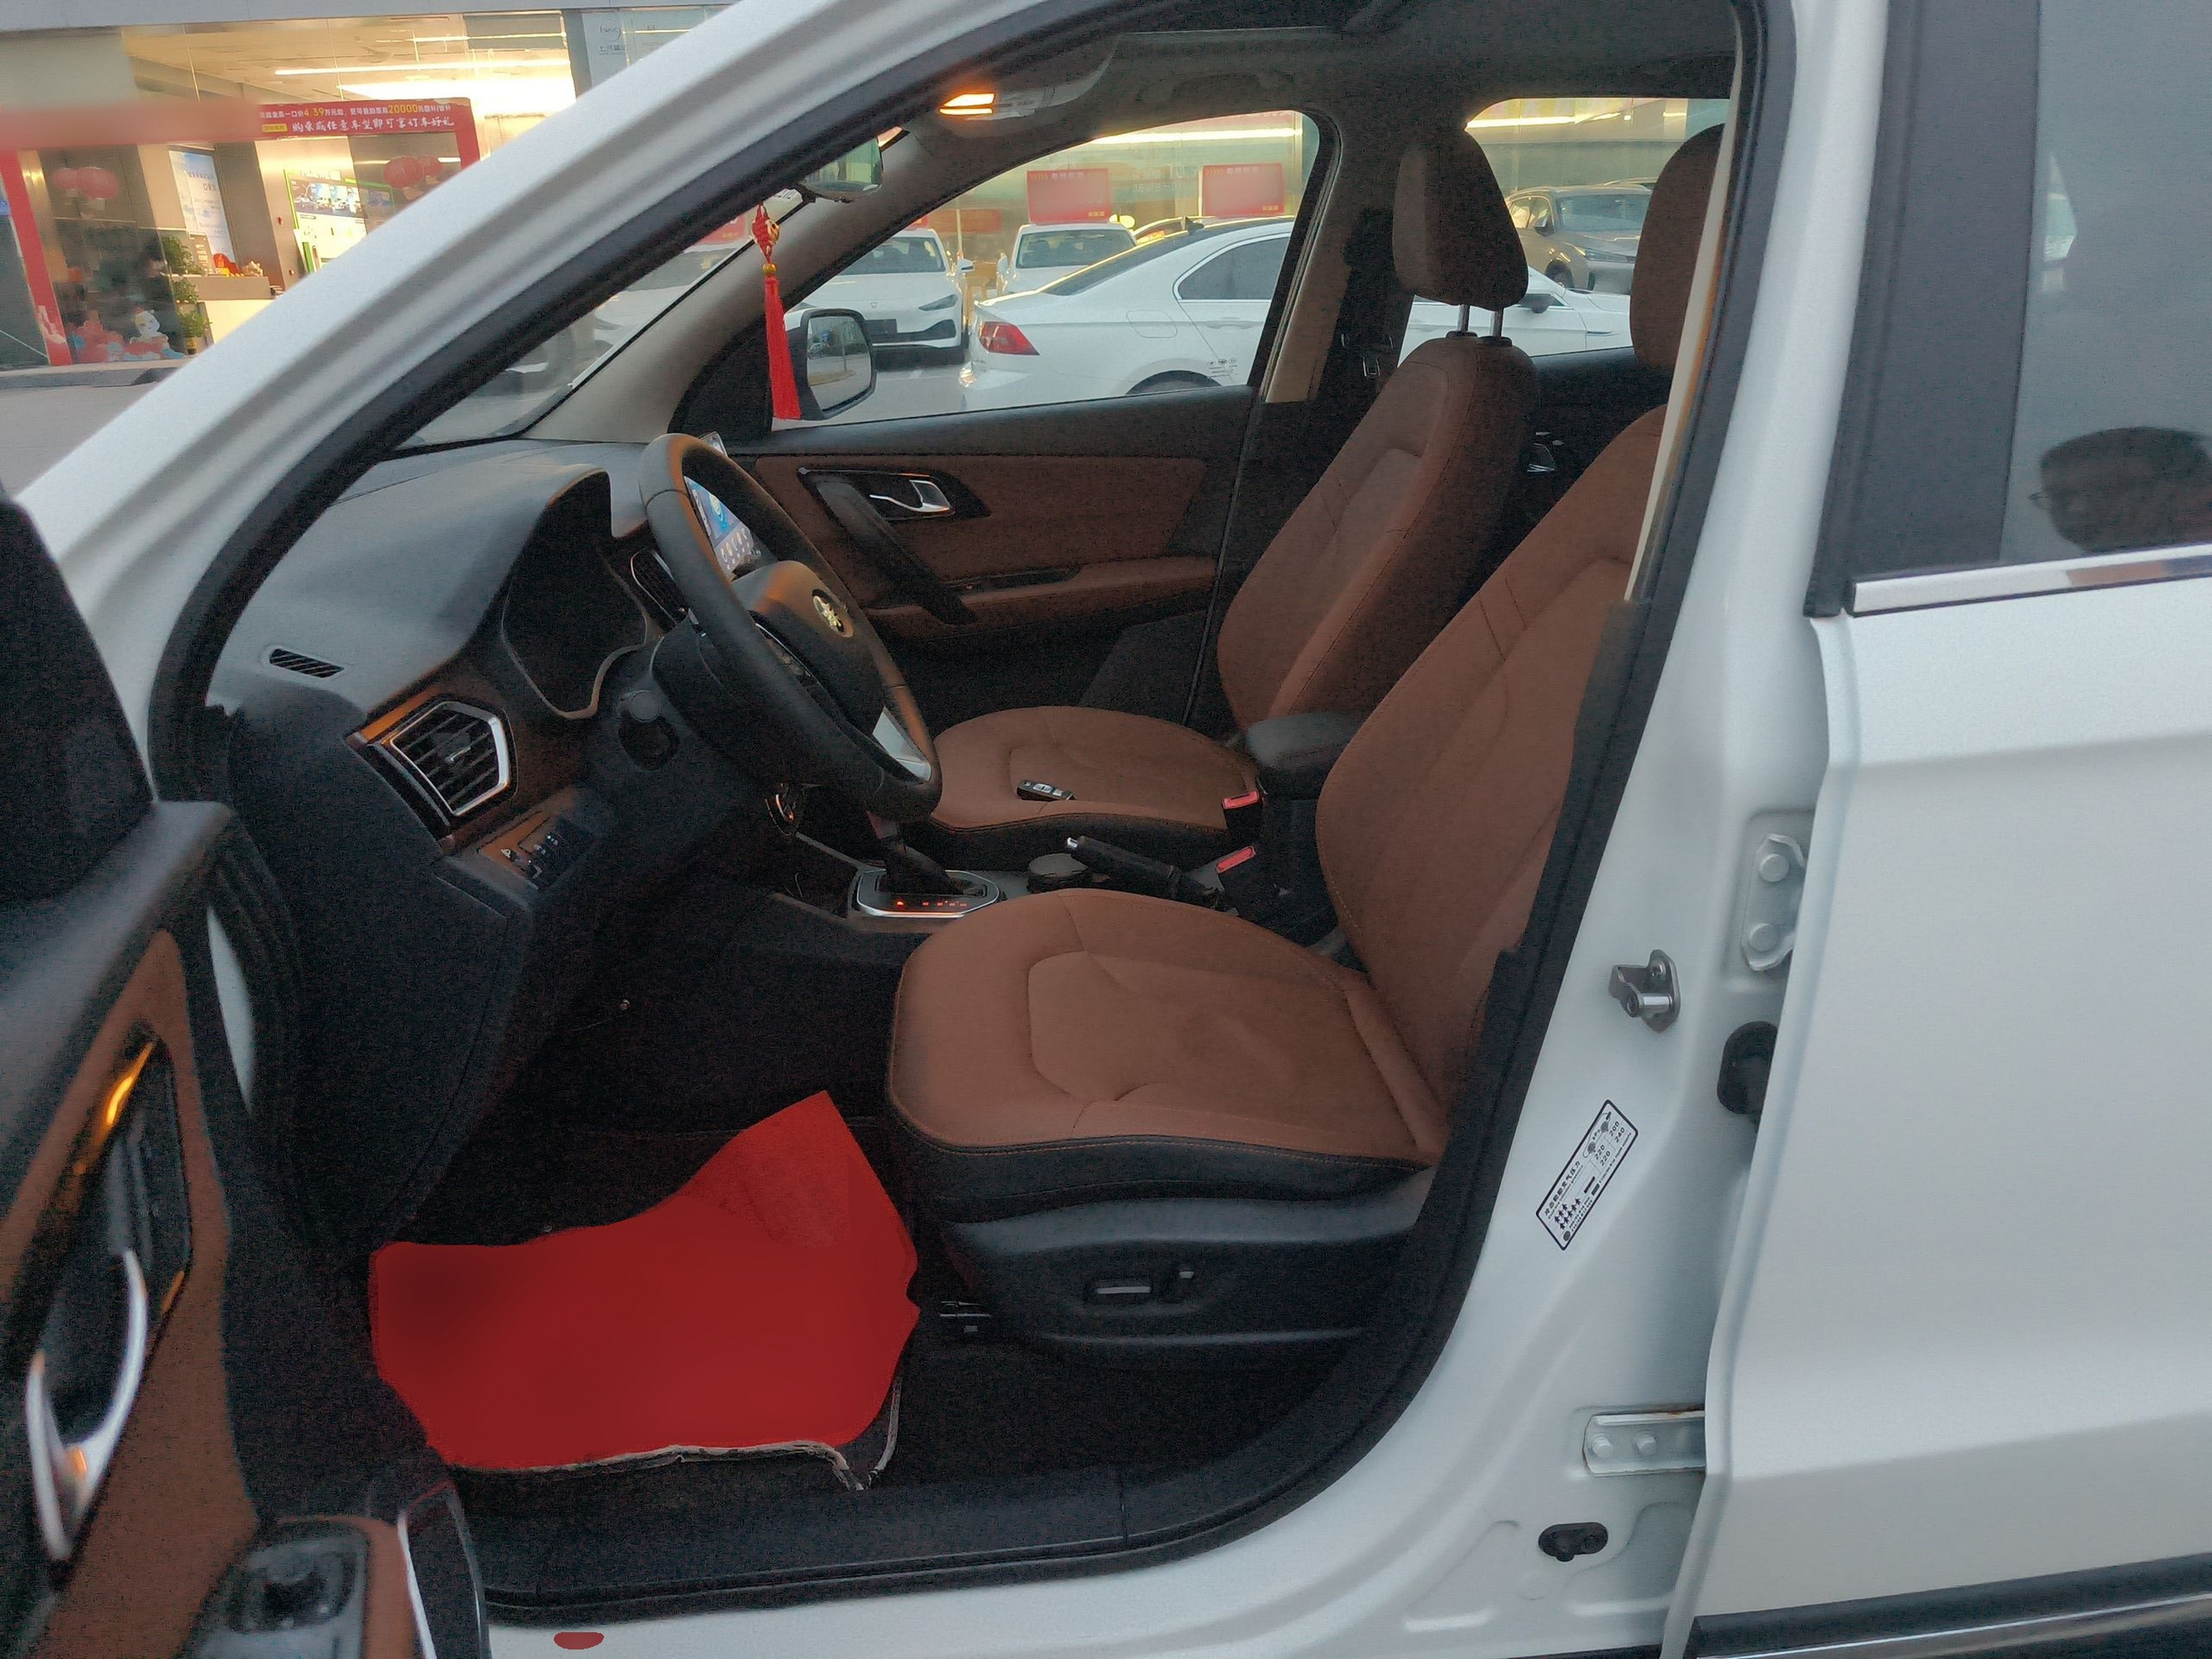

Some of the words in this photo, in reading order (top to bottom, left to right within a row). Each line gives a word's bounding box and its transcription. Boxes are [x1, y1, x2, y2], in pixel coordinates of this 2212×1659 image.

[1608, 1120, 1620, 1137] 200
[1614, 1127, 1626, 1143] 240
[1594, 1144, 1605, 1160] 220
[1600, 1150, 1611, 1167] 220
